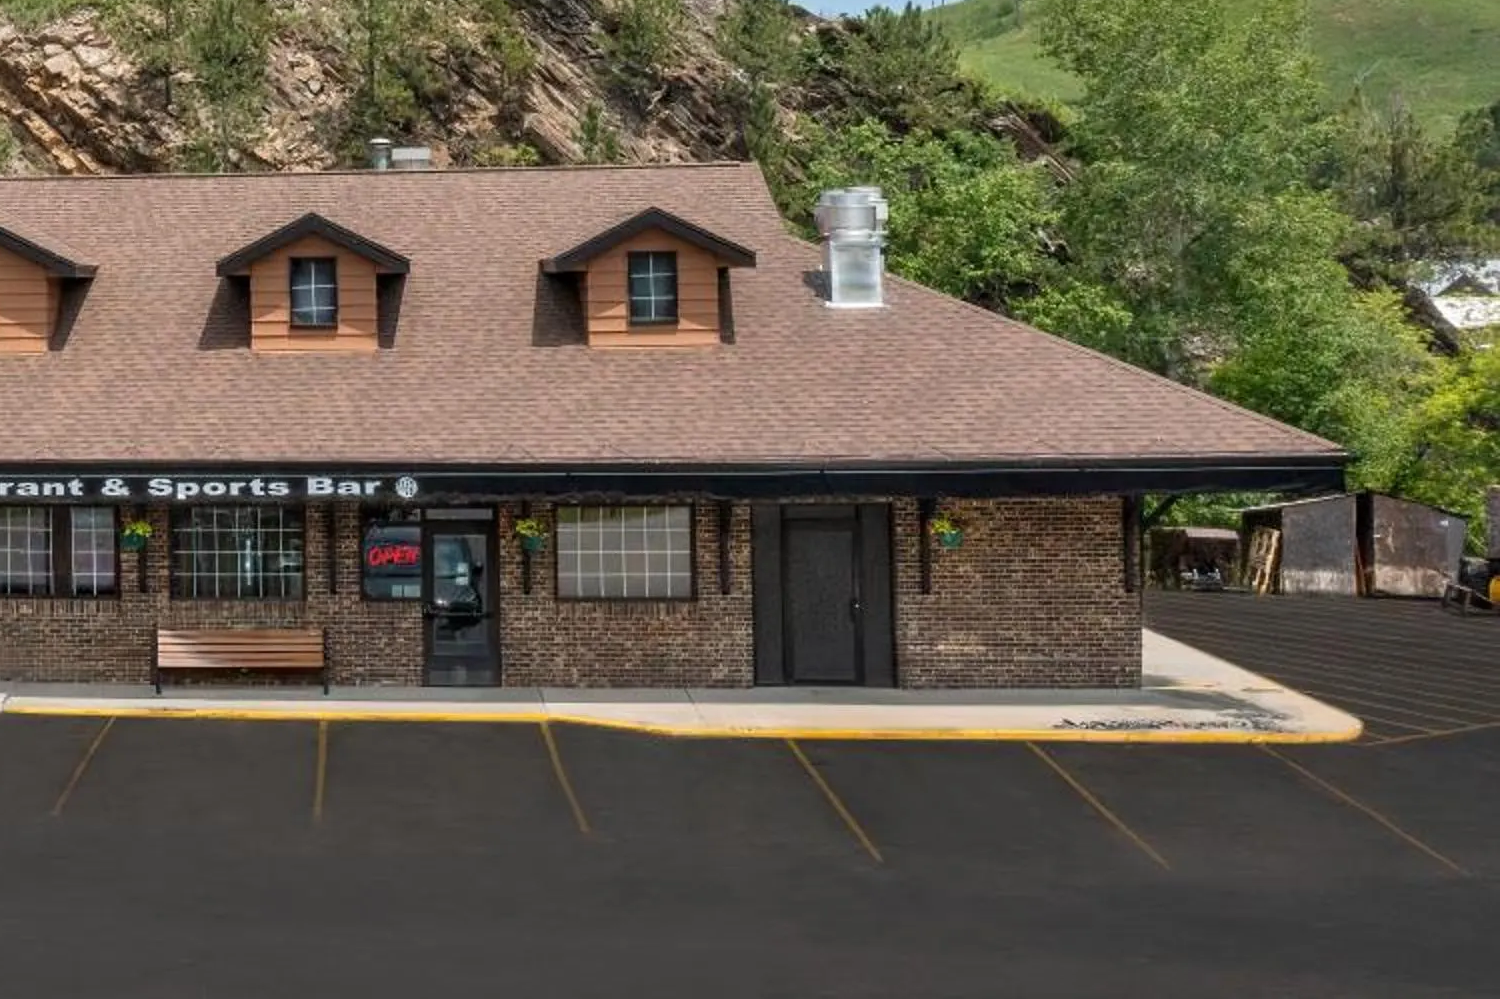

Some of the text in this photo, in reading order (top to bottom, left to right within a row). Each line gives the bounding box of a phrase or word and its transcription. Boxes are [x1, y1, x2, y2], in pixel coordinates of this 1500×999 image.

[101, 478, 131, 497] &
[147, 478, 290, 500] Sports
[306, 476, 381, 496] Bar
